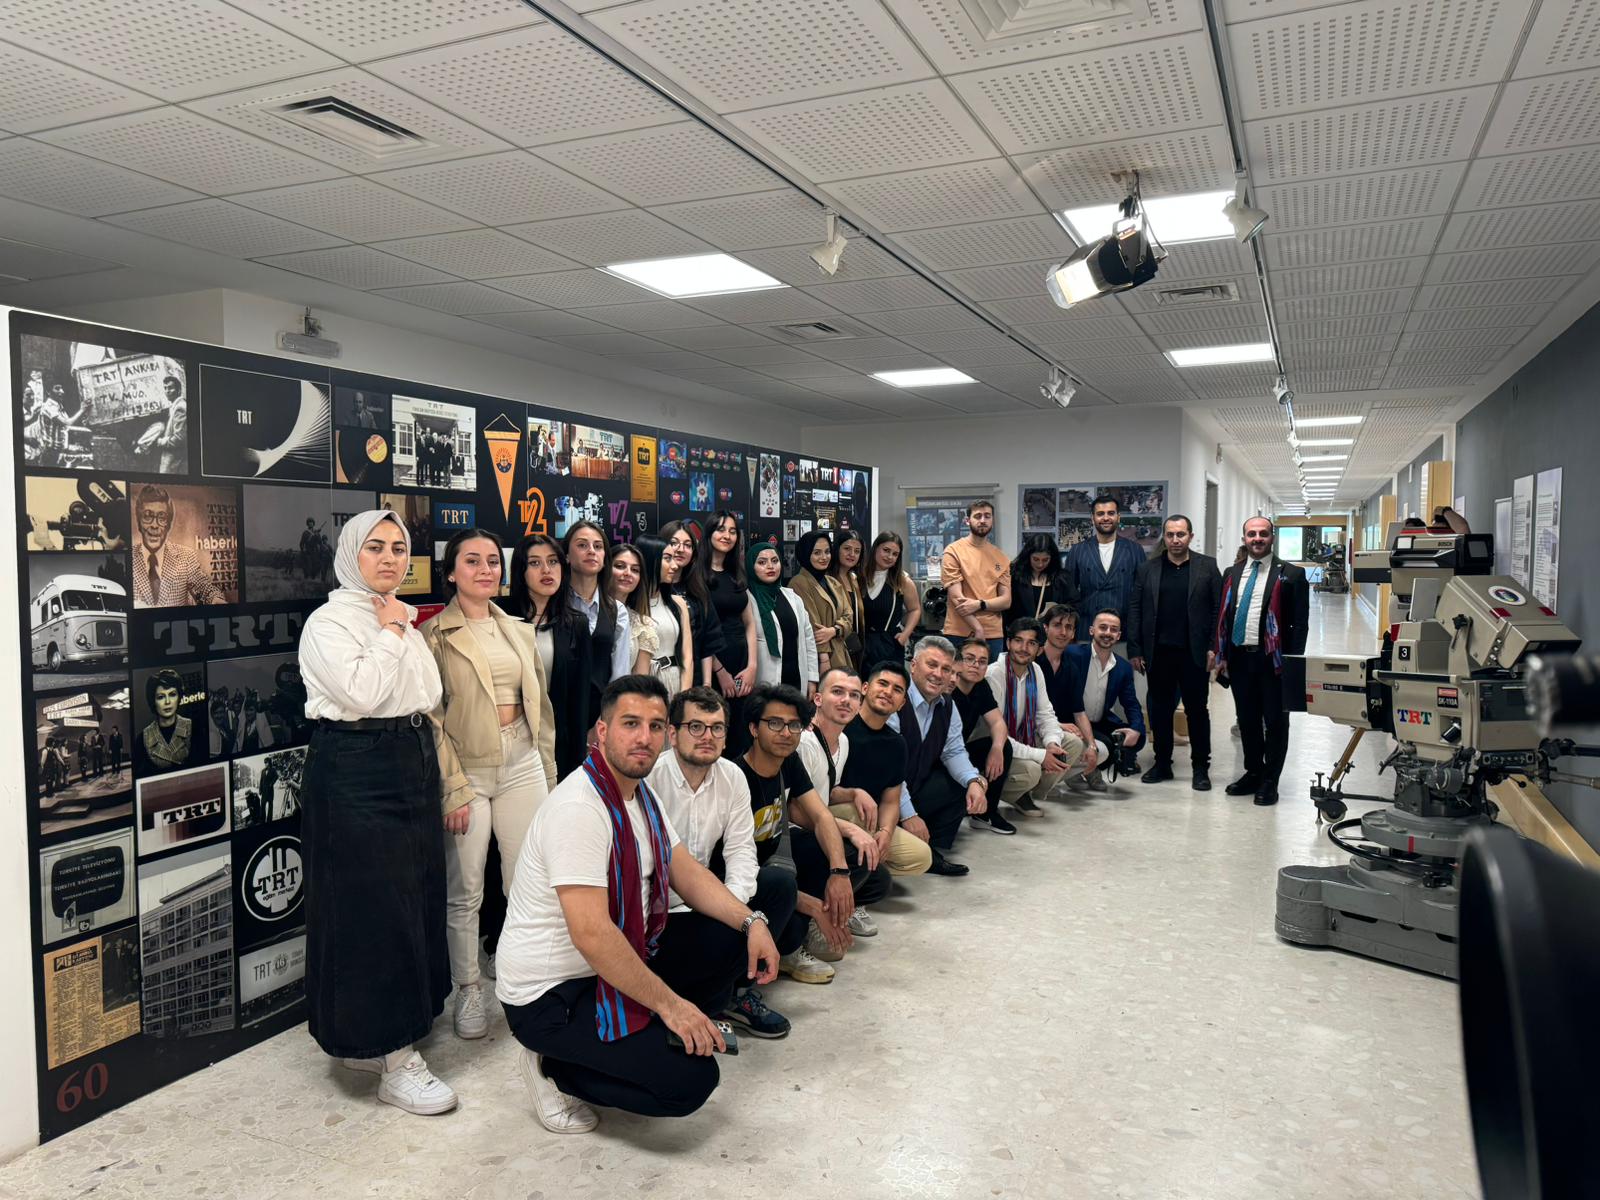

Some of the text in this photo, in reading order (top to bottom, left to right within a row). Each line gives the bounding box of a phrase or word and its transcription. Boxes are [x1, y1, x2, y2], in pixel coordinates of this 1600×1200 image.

[93, 362, 159, 383] TRT ANKARA
[236, 409, 253, 425] TRT
[441, 509, 469, 524] TRT
[153, 611, 303, 656] TRT
[1401, 647, 1409, 658] 3
[1397, 708, 1432, 726] TRT
[163, 799, 221, 825] TRT
[257, 866, 299, 896] TRT
[253, 960, 272, 982] TRT
[56, 1062, 109, 1113] 60
